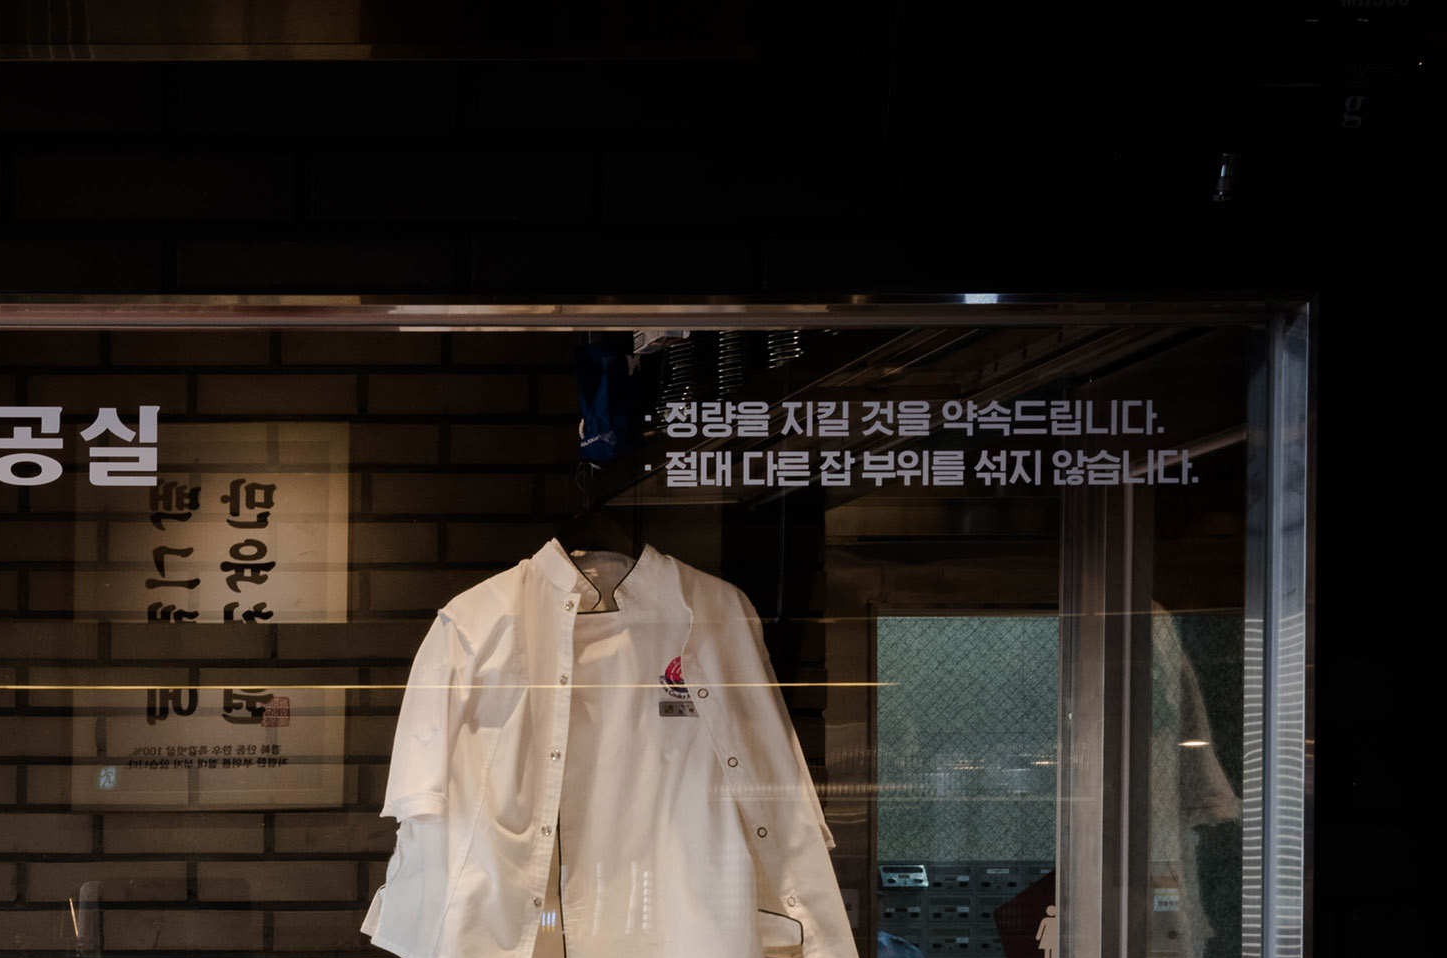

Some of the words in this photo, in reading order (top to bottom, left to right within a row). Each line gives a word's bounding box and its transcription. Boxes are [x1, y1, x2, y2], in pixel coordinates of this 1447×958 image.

[665, 401, 771, 438] 정량을
[781, 401, 850, 437] 지킬
[861, 400, 931, 436] 것을
[942, 400, 1165, 436] 약속드립니다.
[665, 450, 732, 488] 절대
[742, 450, 811, 487] 다른
[820, 450, 856, 487] 잡
[861, 450, 966, 487] 부위를
[974, 450, 1041, 486] 섞지
[1052, 449, 1199, 486] 않습니다.
